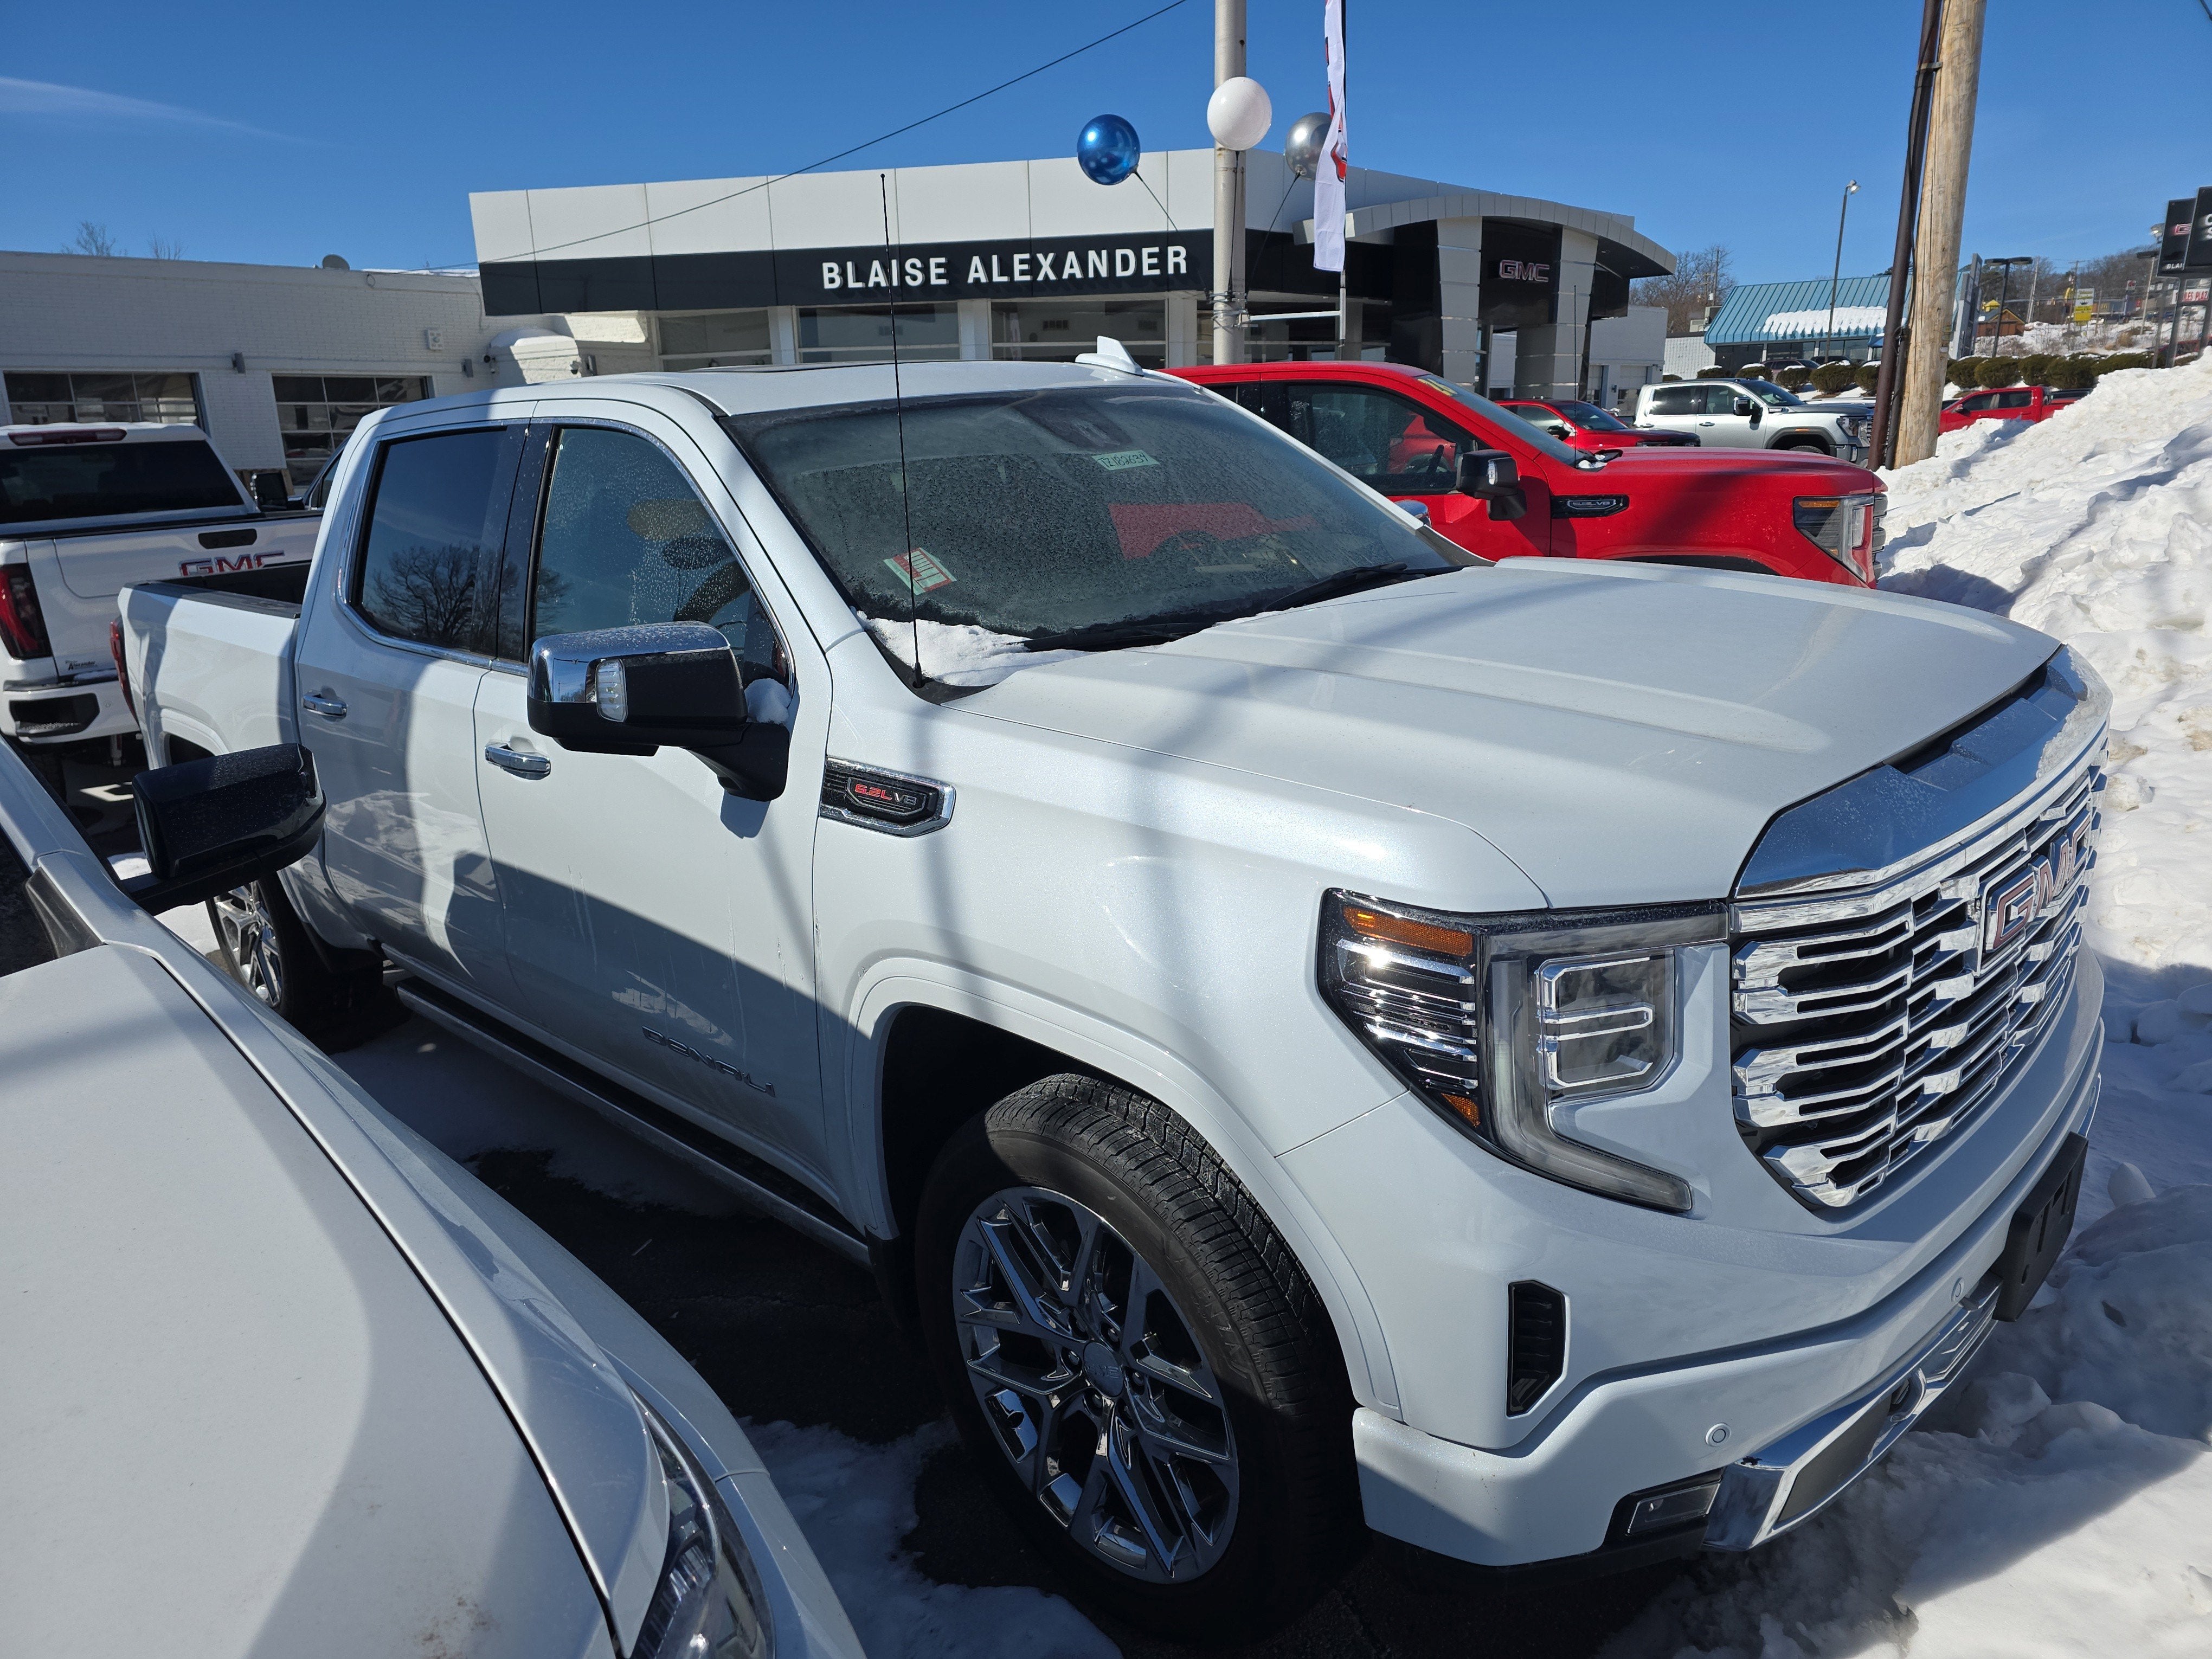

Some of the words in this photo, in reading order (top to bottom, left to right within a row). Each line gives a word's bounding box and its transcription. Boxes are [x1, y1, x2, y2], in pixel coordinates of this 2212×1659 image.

[822, 256, 949, 290] BLAISE
[967, 245, 1188, 284] ALEXANDER
[1499, 260, 1549, 282] GMC
[1986, 809, 2091, 953] GMC
